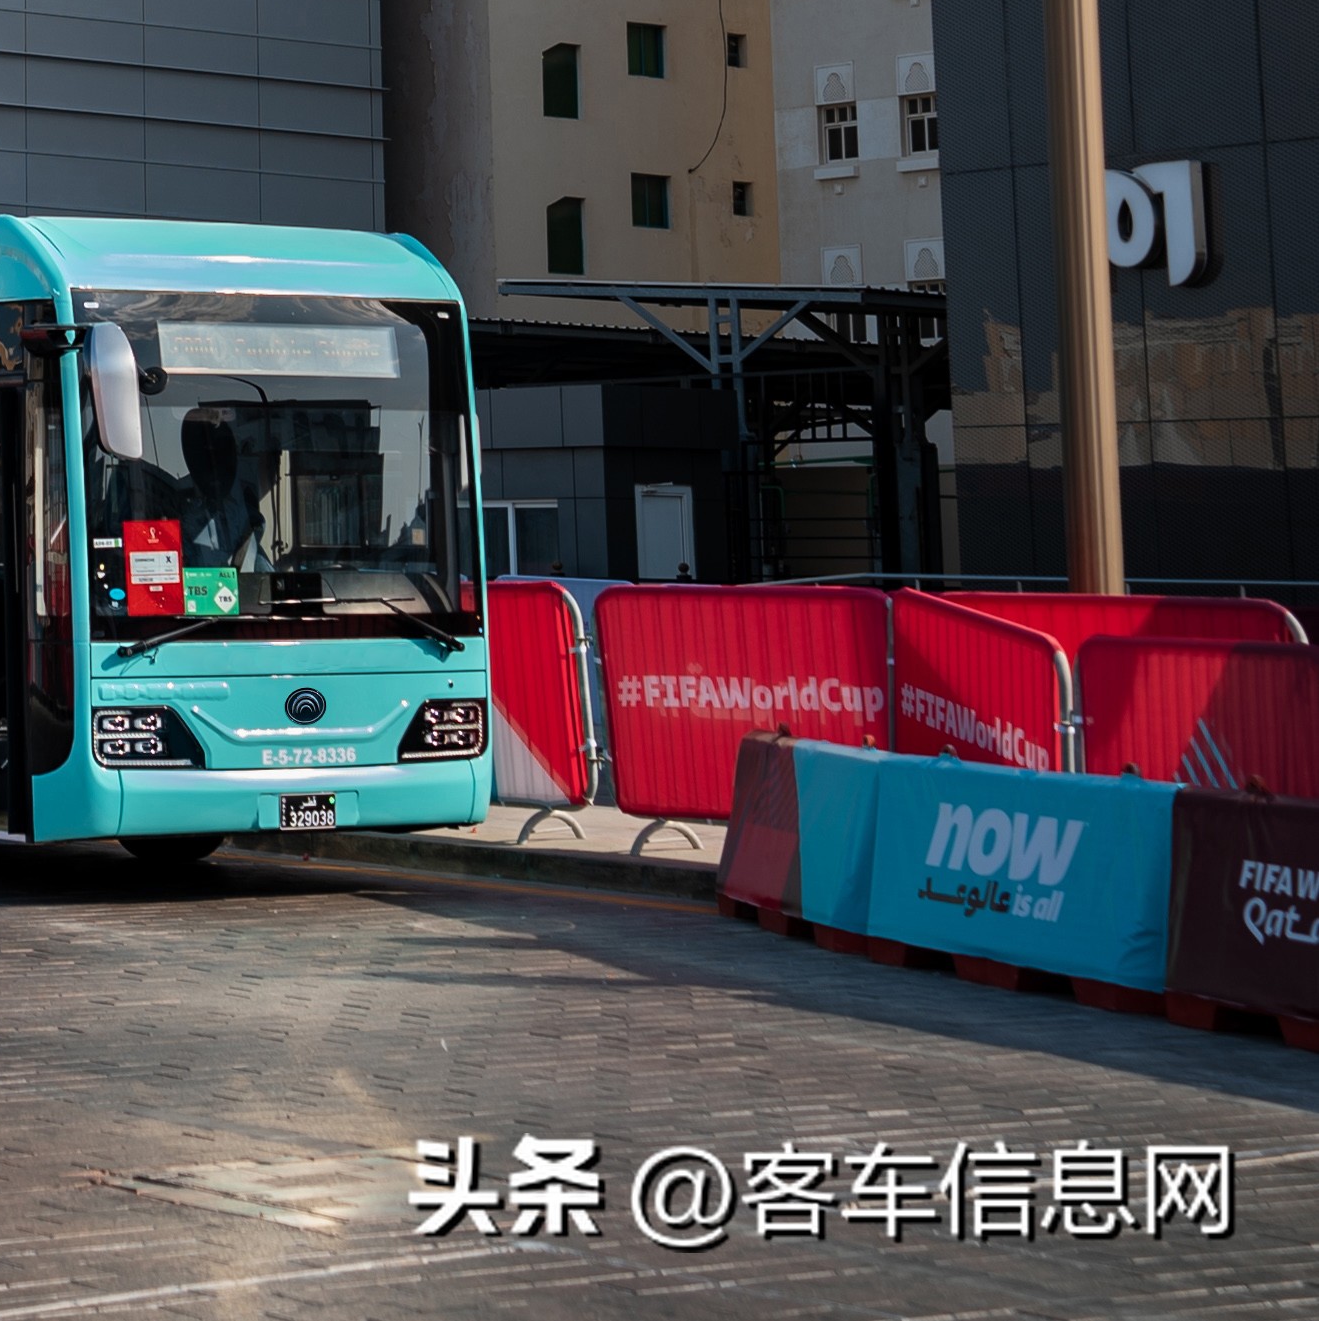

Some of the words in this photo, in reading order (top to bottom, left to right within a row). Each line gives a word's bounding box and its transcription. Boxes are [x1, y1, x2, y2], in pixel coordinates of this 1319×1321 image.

[188, 586, 208, 596] TBS
[617, 675, 884, 722] #FIFAWorldCup
[901, 683, 1050, 772] #FIFAWorldCup
[262, 747, 356, 765] E-5-72-8336
[289, 810, 334, 827] 329038
[926, 801, 1084, 886] now
[1238, 859, 1293, 897] FIFA
[1012, 884, 1033, 918] is
[1032, 889, 1065, 923] all
